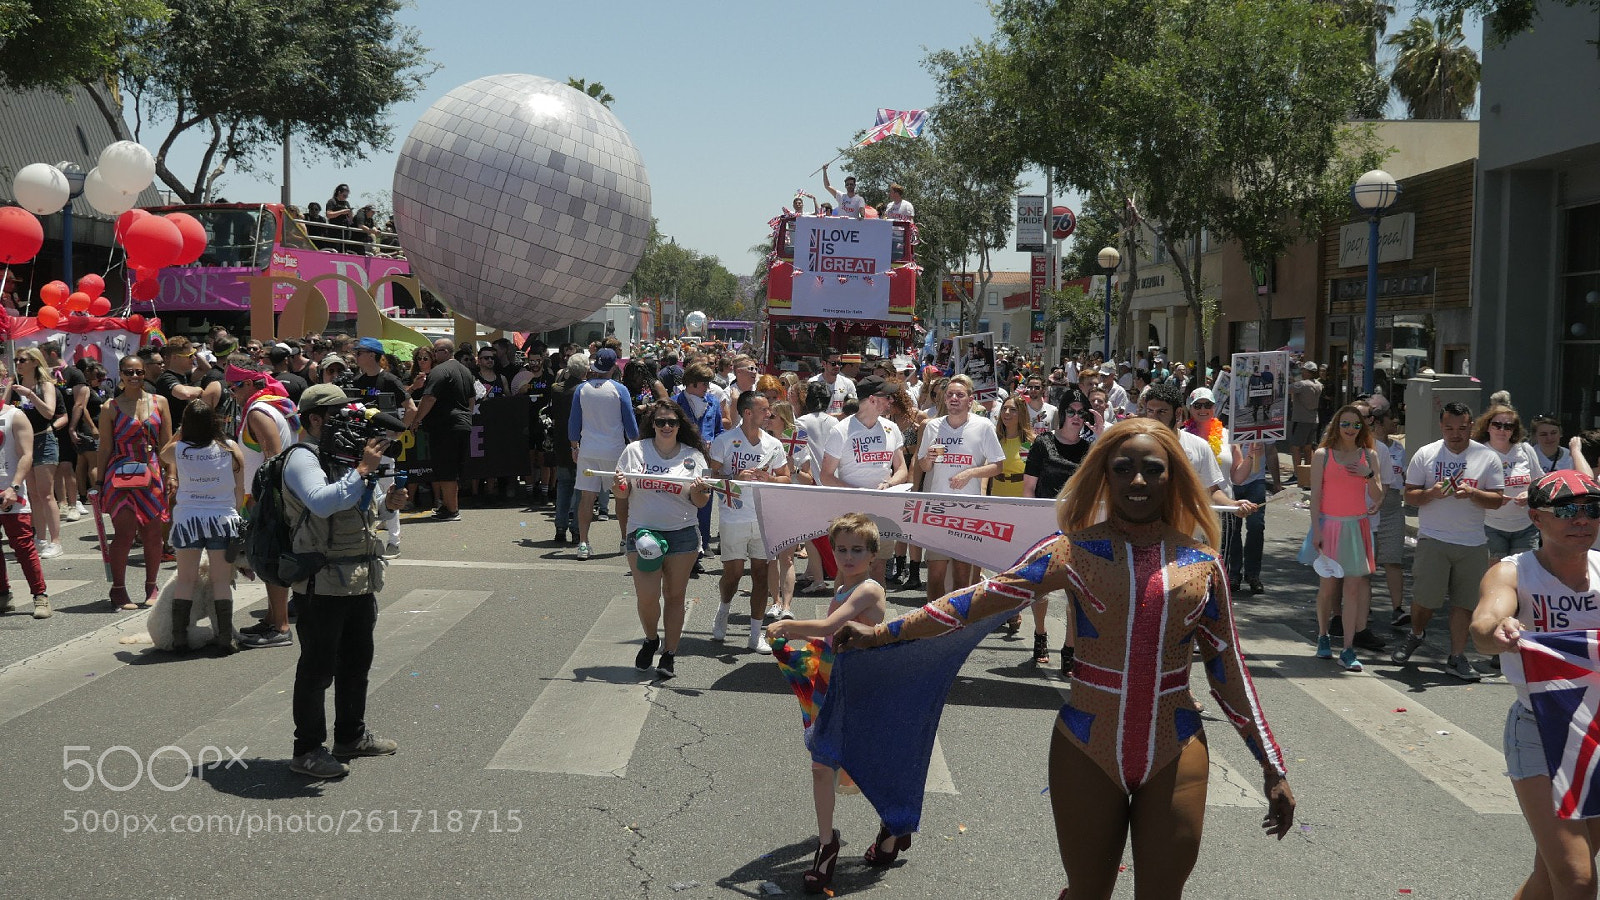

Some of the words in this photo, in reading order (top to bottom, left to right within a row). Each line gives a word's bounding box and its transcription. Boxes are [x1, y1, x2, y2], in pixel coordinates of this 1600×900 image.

[1018, 207, 1043, 217] ONE
[1018, 217, 1043, 225] PRIDE
[1051, 213, 1072, 231] 76
[822, 229, 860, 243] LOVE
[821, 243, 835, 255] IS
[822, 258, 874, 273] GREAT
[159, 273, 220, 306] OSE
[105, 335, 131, 356] ALIVE
[859, 435, 883, 445] LOVE
[940, 437, 963, 445] LOVE
[740, 453, 761, 463] LOVE
[863, 452, 892, 462] GREAT
[943, 454, 973, 465] GREAT
[738, 461, 747, 469] IS
[1443, 462, 1467, 470] LOVE
[1442, 469, 1452, 477] IS
[644, 479, 683, 494] GREAT
[923, 503, 946, 515] IS
[925, 514, 1011, 539] GREAT
[947, 529, 983, 544] BRITAIN
[1547, 594, 1598, 612] LOVE
[1550, 612, 1570, 629] IS
